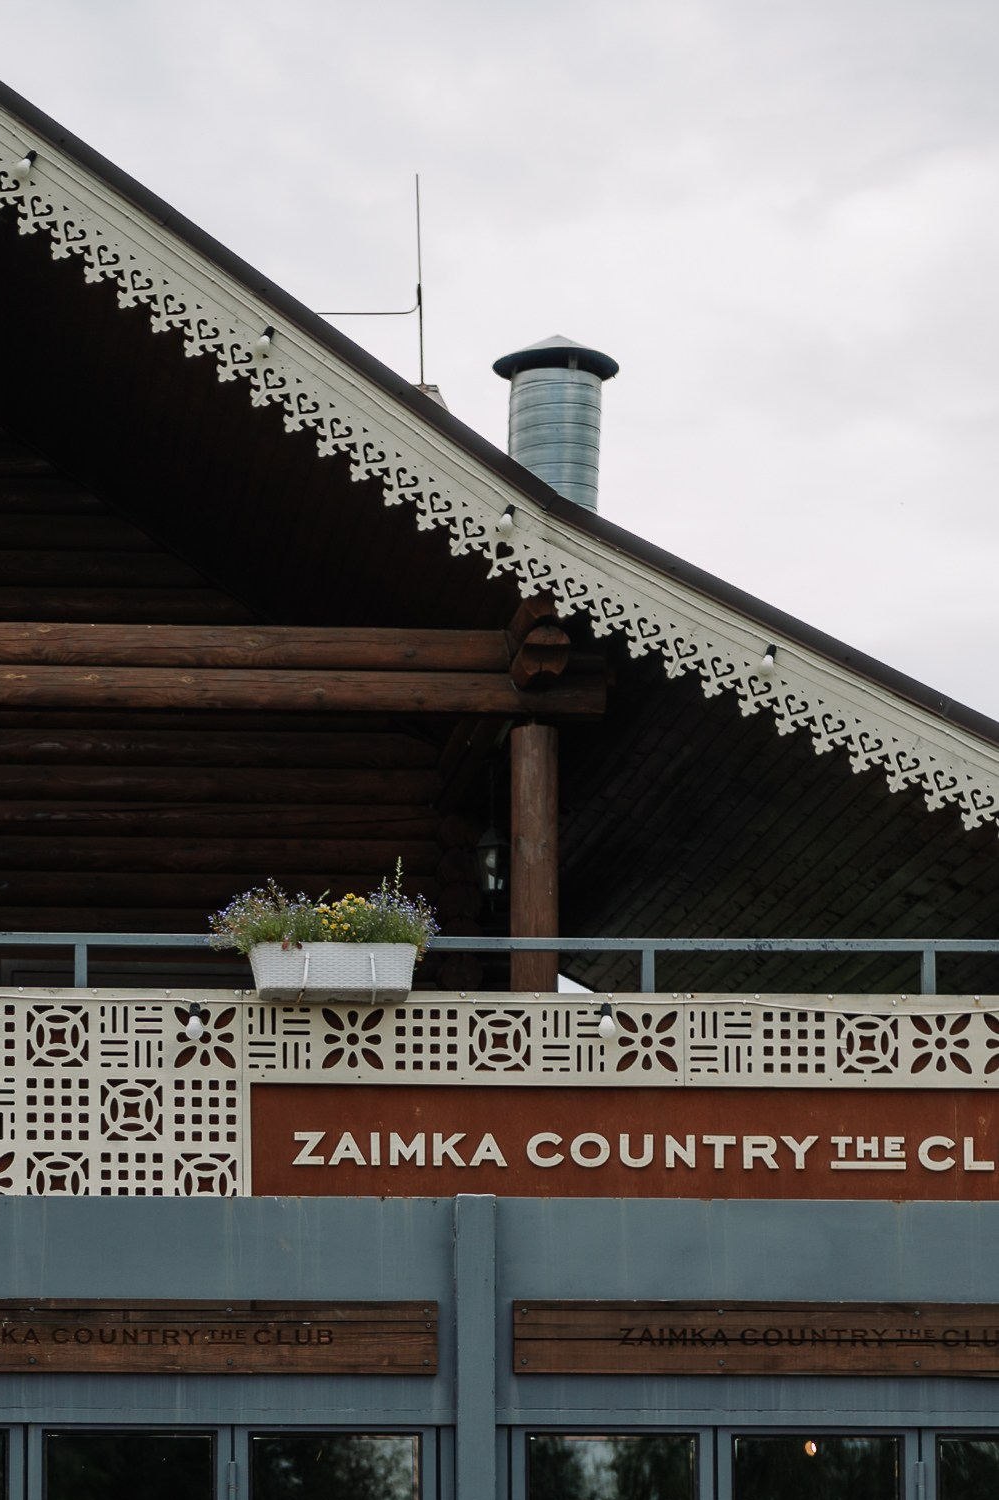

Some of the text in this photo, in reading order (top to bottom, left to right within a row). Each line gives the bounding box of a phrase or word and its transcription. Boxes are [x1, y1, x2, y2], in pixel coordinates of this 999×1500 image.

[292, 1131, 995, 1171] ZAIMKA COUNTRY THE CL
[51, 1328, 201, 1345] COUNTRY
[208, 1329, 247, 1342] THE
[253, 1329, 335, 1346] CLUB
[619, 1327, 731, 1347] ZAIMKA
[740, 1328, 889, 1347] COUNTRY
[896, 1329, 936, 1343] THE
